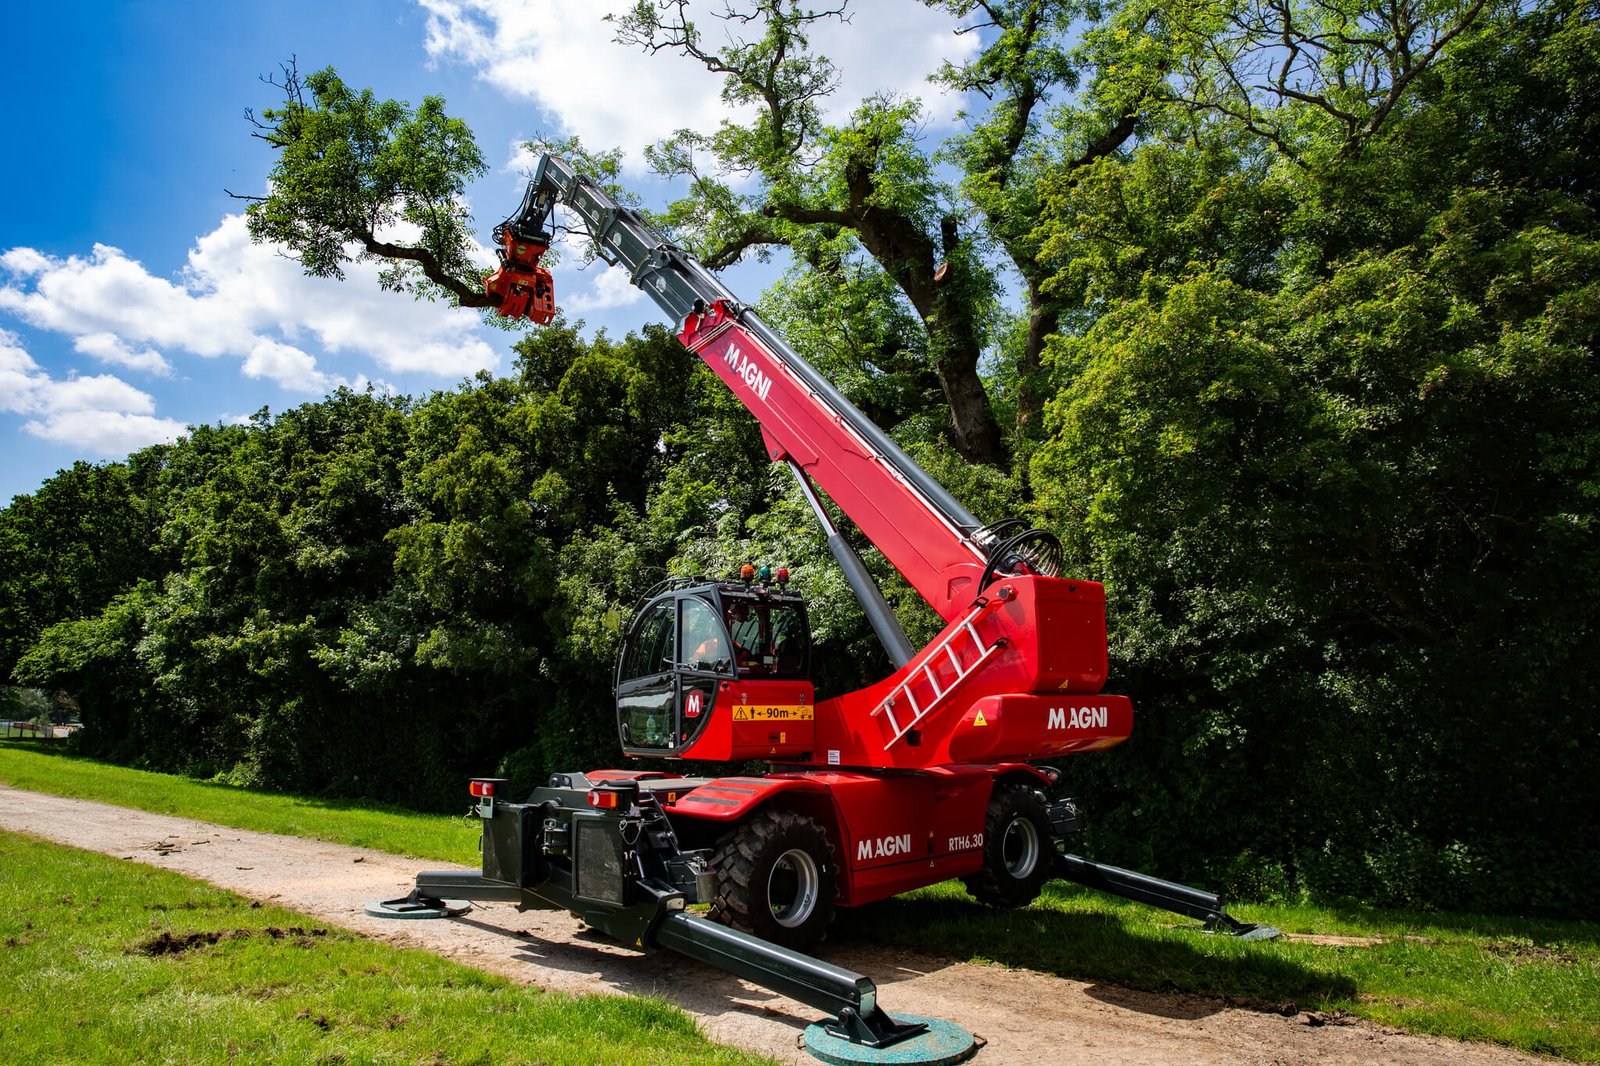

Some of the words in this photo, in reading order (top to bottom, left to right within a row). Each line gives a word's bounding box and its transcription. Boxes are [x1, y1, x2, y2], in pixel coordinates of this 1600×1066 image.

[724, 343, 772, 400] MAGNI
[688, 695, 699, 712] M
[767, 708, 788, 718] 90m
[1048, 707, 1107, 729] MAGNI
[858, 834, 911, 860] MAGNI
[949, 833, 984, 851] RTH6.30
